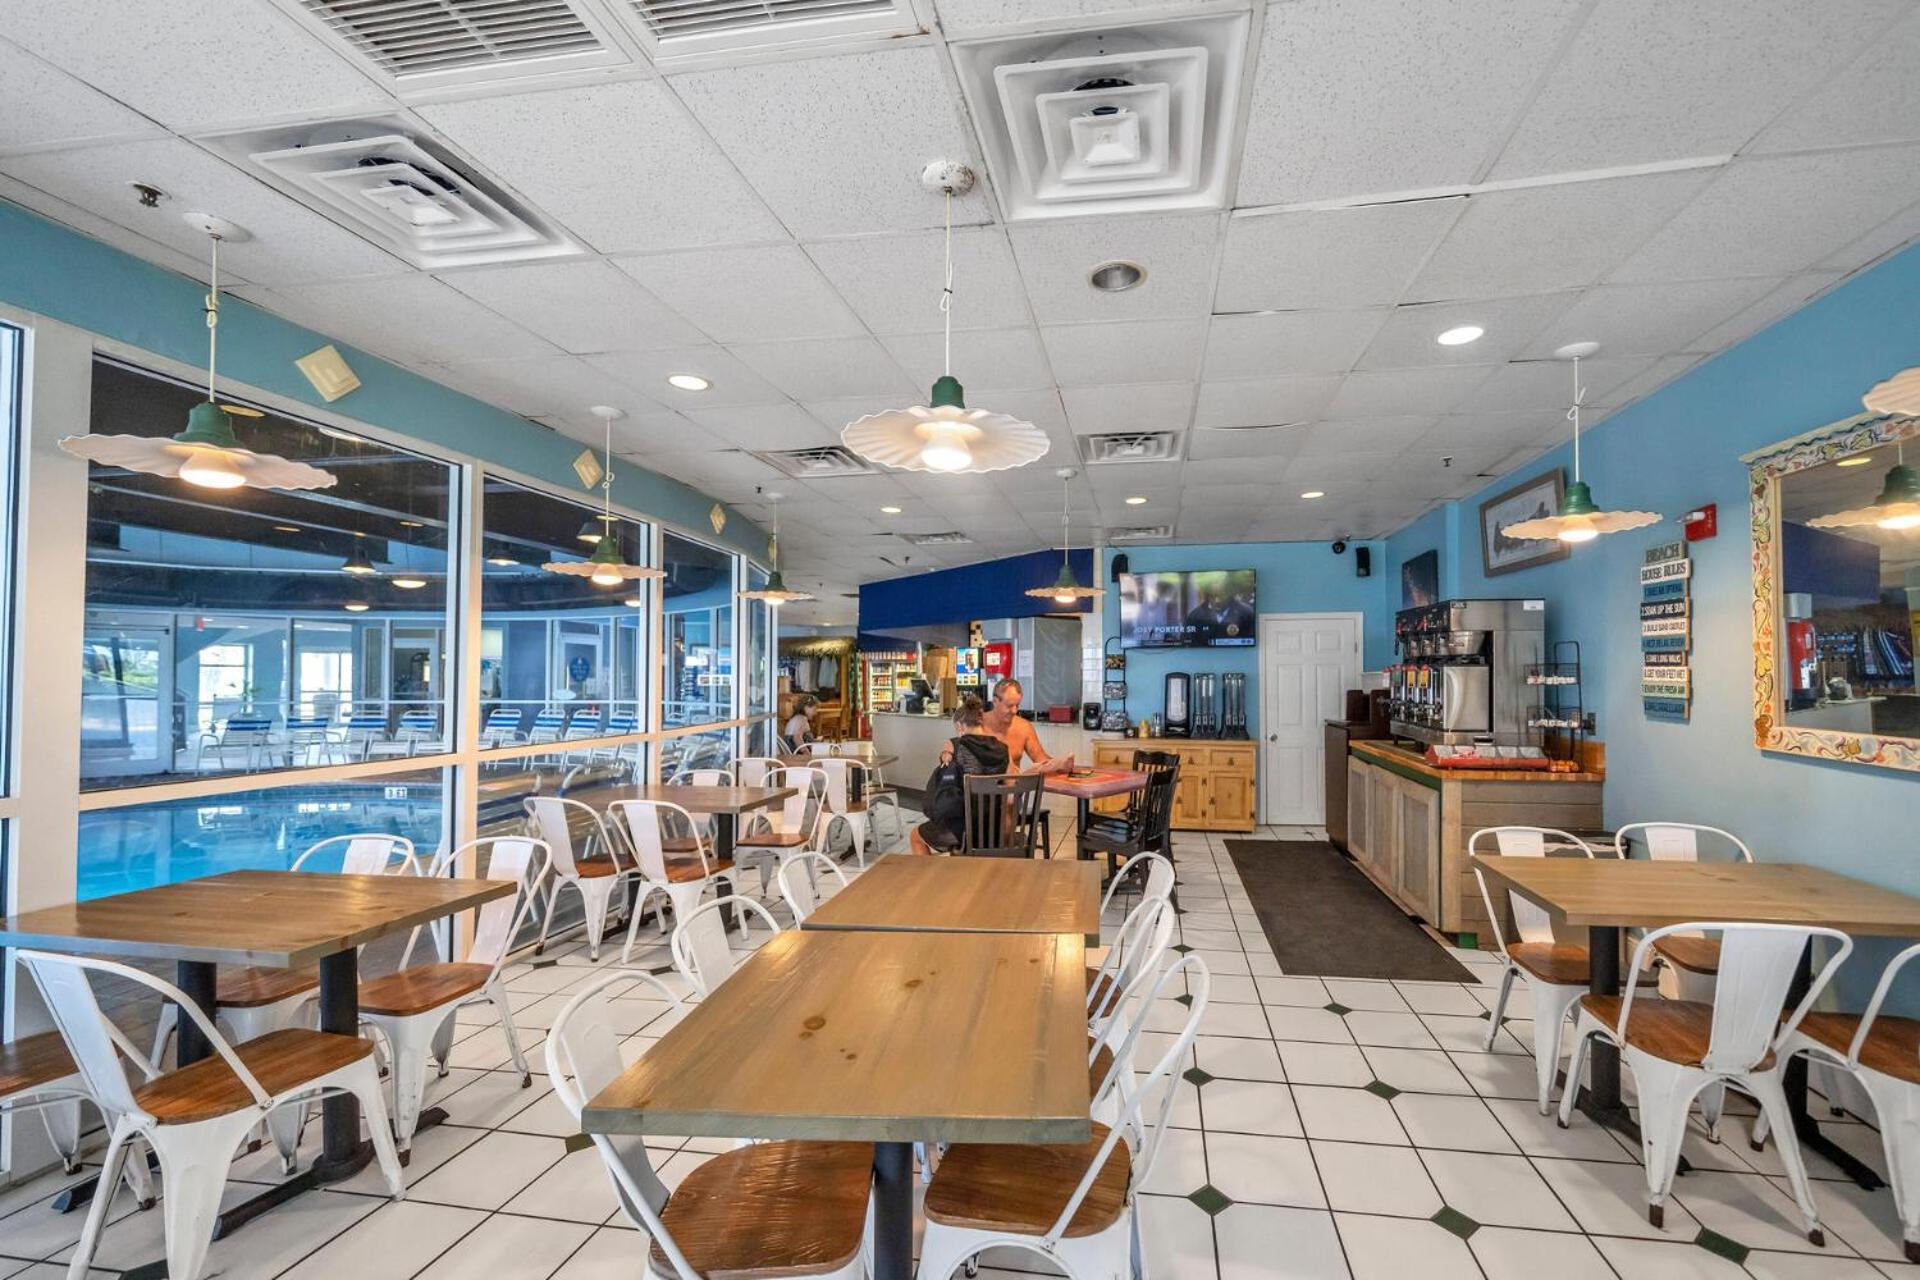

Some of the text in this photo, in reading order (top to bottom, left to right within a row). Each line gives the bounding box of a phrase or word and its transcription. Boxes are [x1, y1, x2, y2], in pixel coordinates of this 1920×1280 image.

[1646, 544, 1680, 563] BEACH
[1641, 561, 1686, 581] HOUSE RULES
[1155, 625, 1185, 634] PORTER
